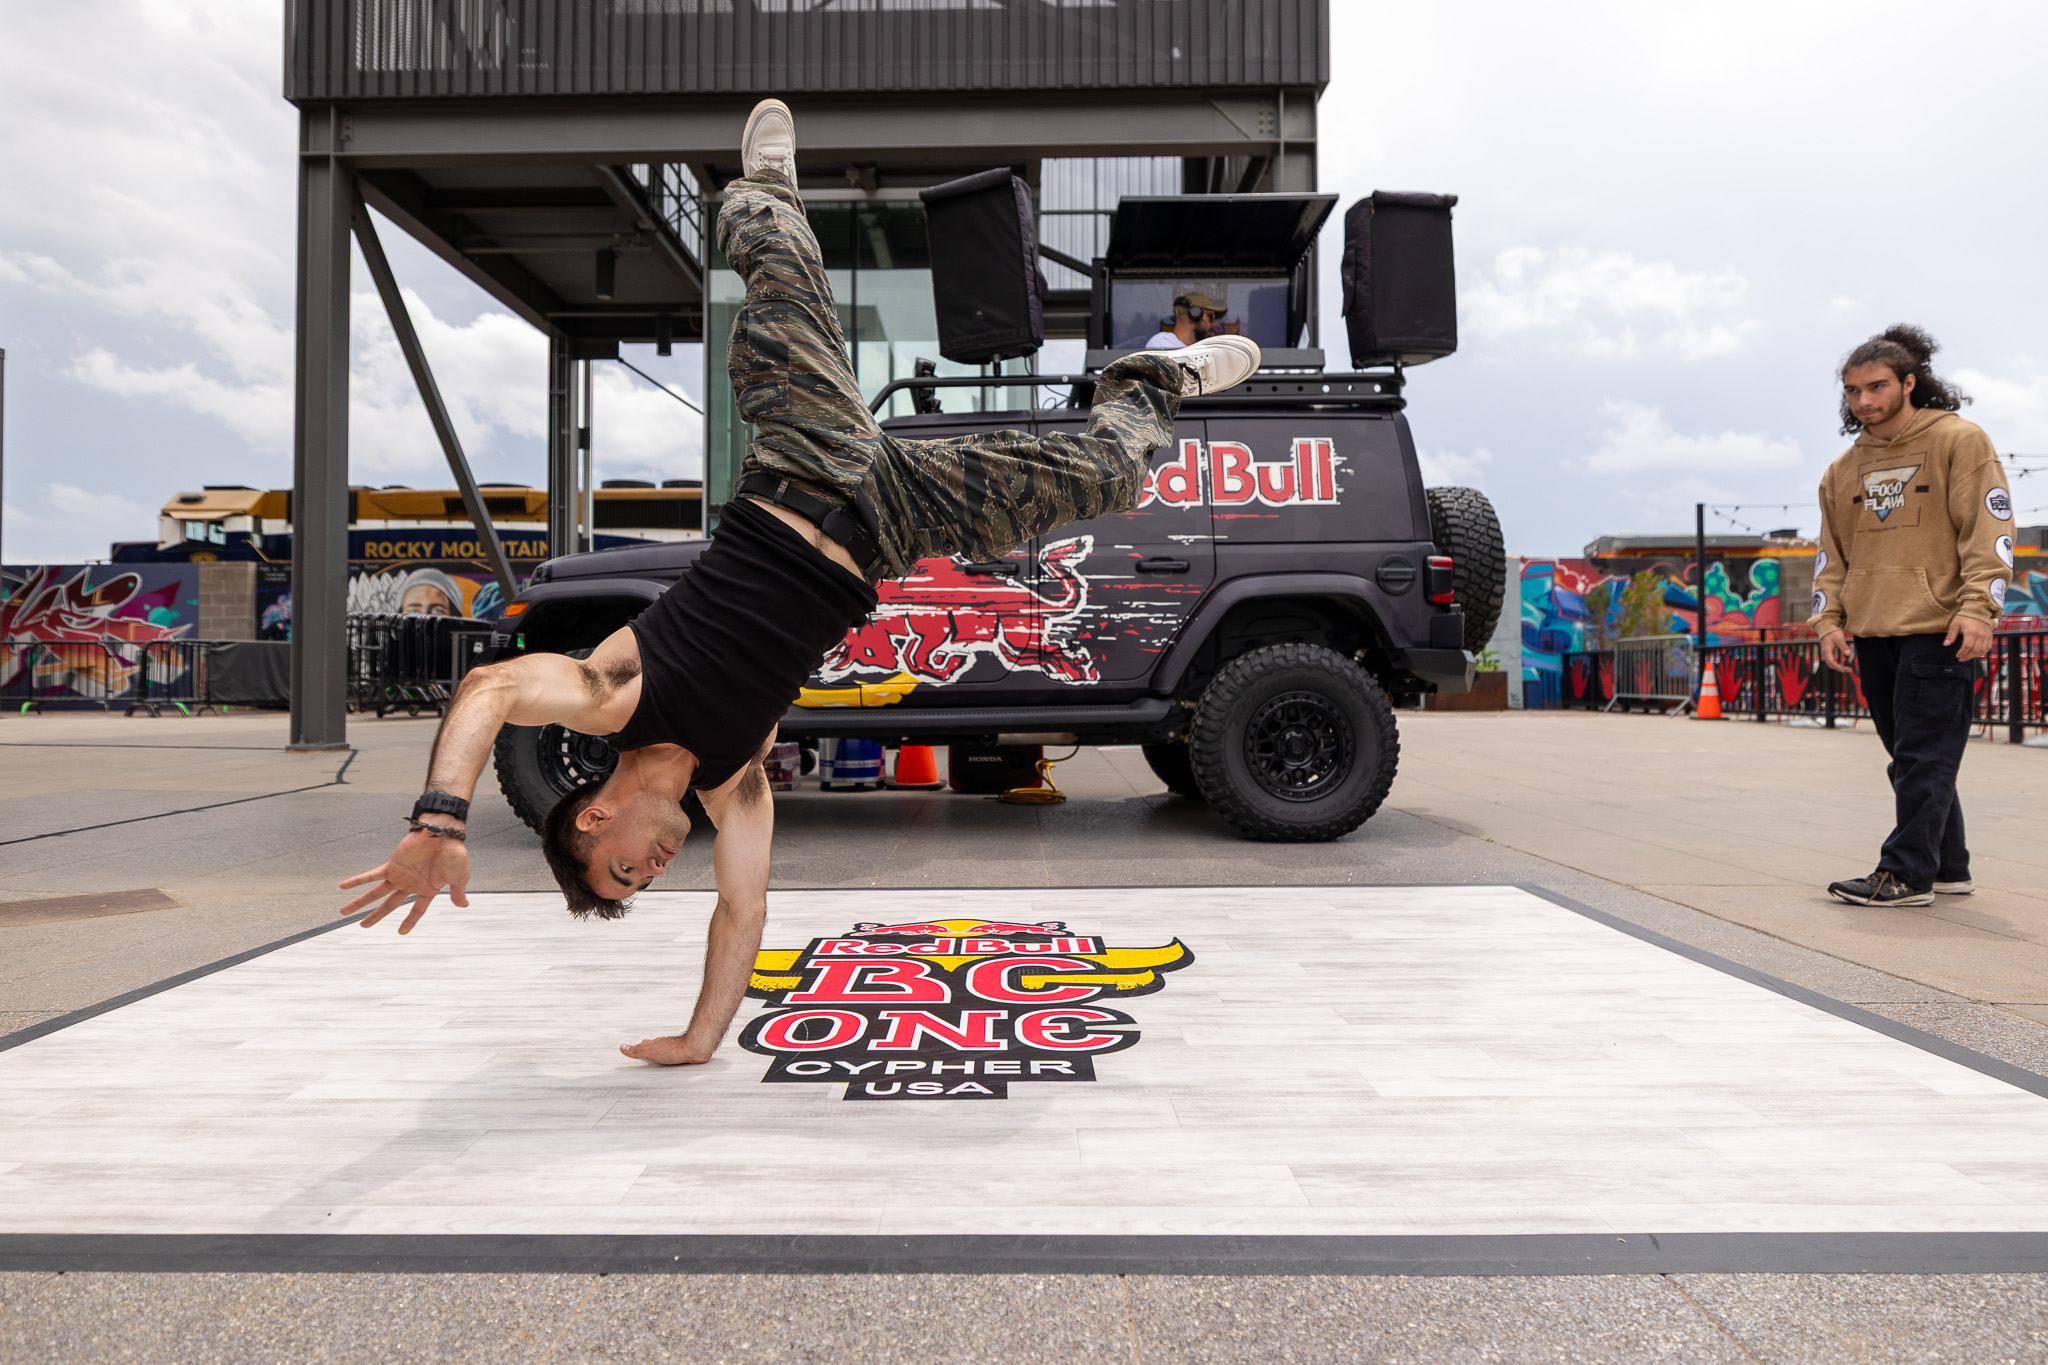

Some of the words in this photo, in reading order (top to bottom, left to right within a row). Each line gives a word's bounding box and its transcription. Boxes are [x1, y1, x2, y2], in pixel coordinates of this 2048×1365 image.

[1208, 438, 1338, 507] Bull
[1863, 493, 1905, 512] FLAVA
[364, 541, 435, 558] ROCKY
[441, 540, 548, 558] MOUTAIN
[812, 938, 956, 955] Red
[960, 937, 1097, 955] Bull
[782, 957, 1102, 1004] BC
[757, 1008, 1127, 1052] ONE
[785, 1060, 1075, 1076] CYPHER
[865, 1082, 993, 1096] USA
